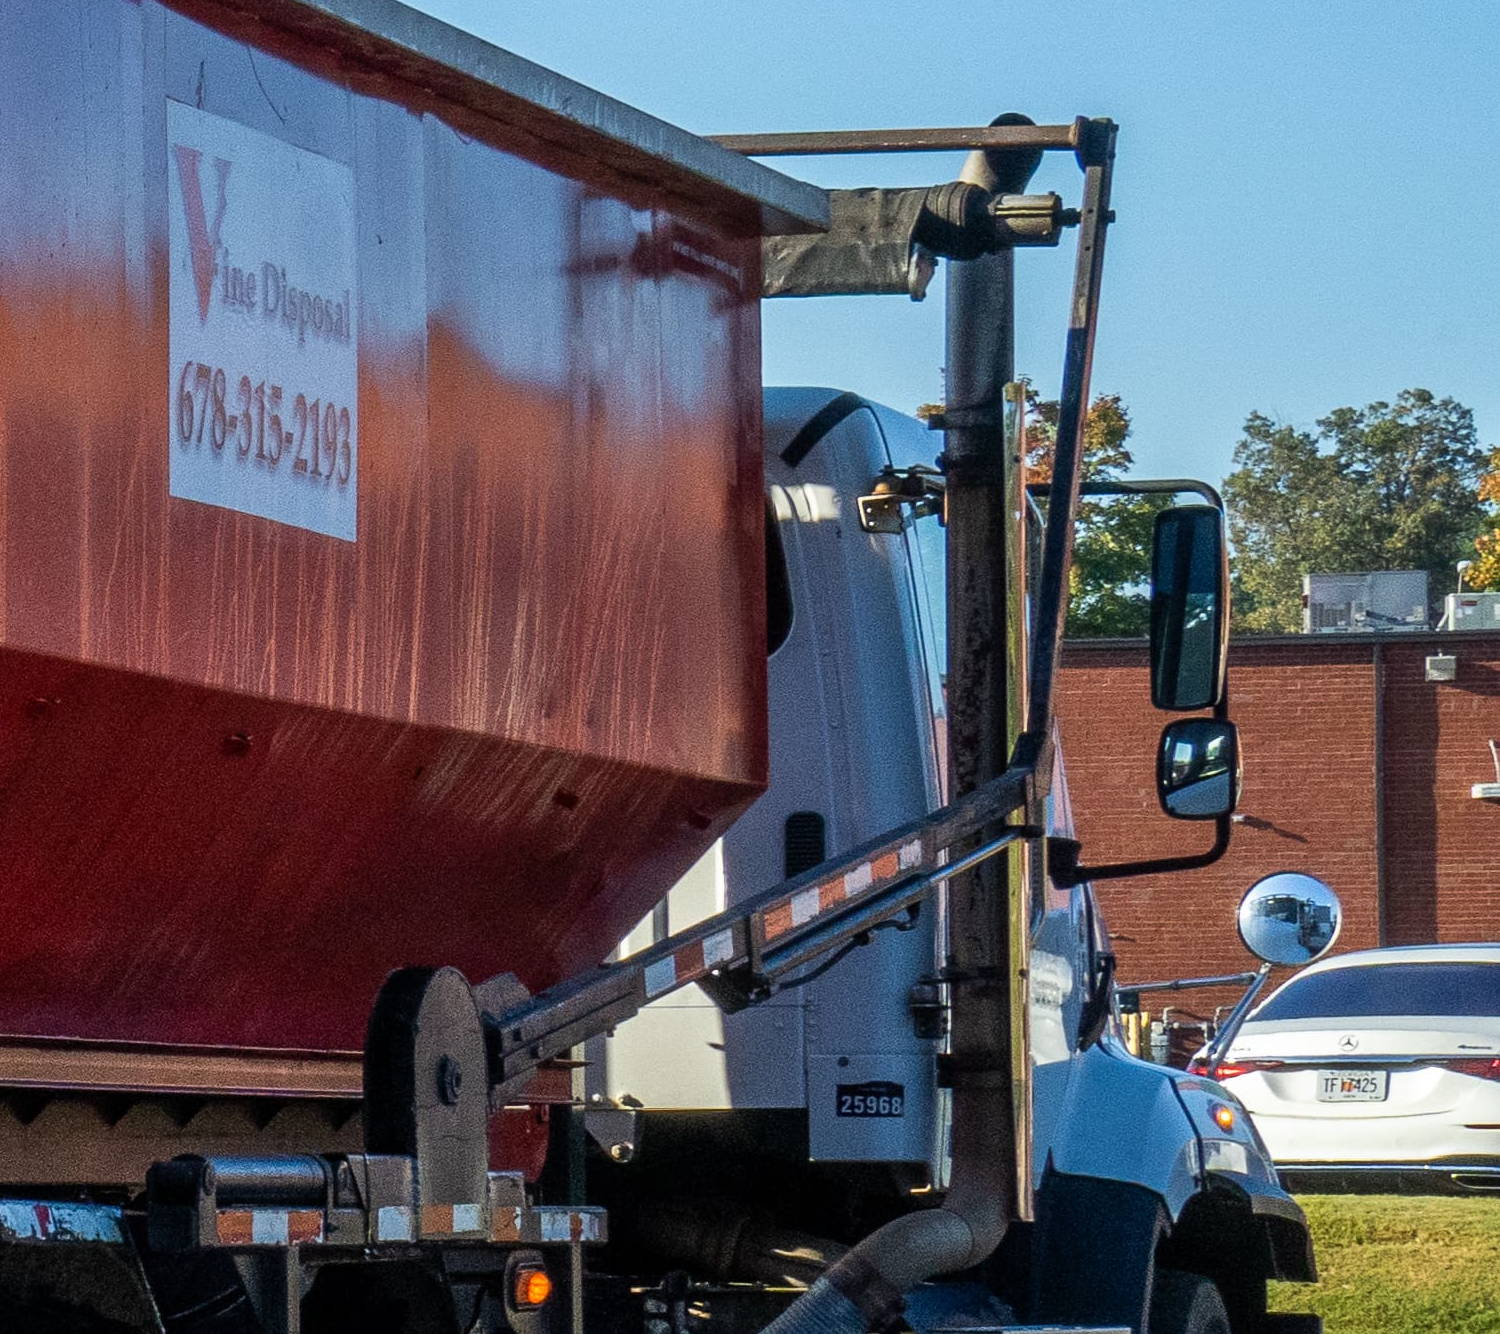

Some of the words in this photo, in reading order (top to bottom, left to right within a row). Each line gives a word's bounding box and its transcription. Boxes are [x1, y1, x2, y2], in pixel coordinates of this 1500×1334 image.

[173, 145, 257, 325] Vine
[261, 261, 351, 346] Disposal
[176, 361, 352, 485] 678-315-2193
[840, 1095, 902, 1115] 25968
